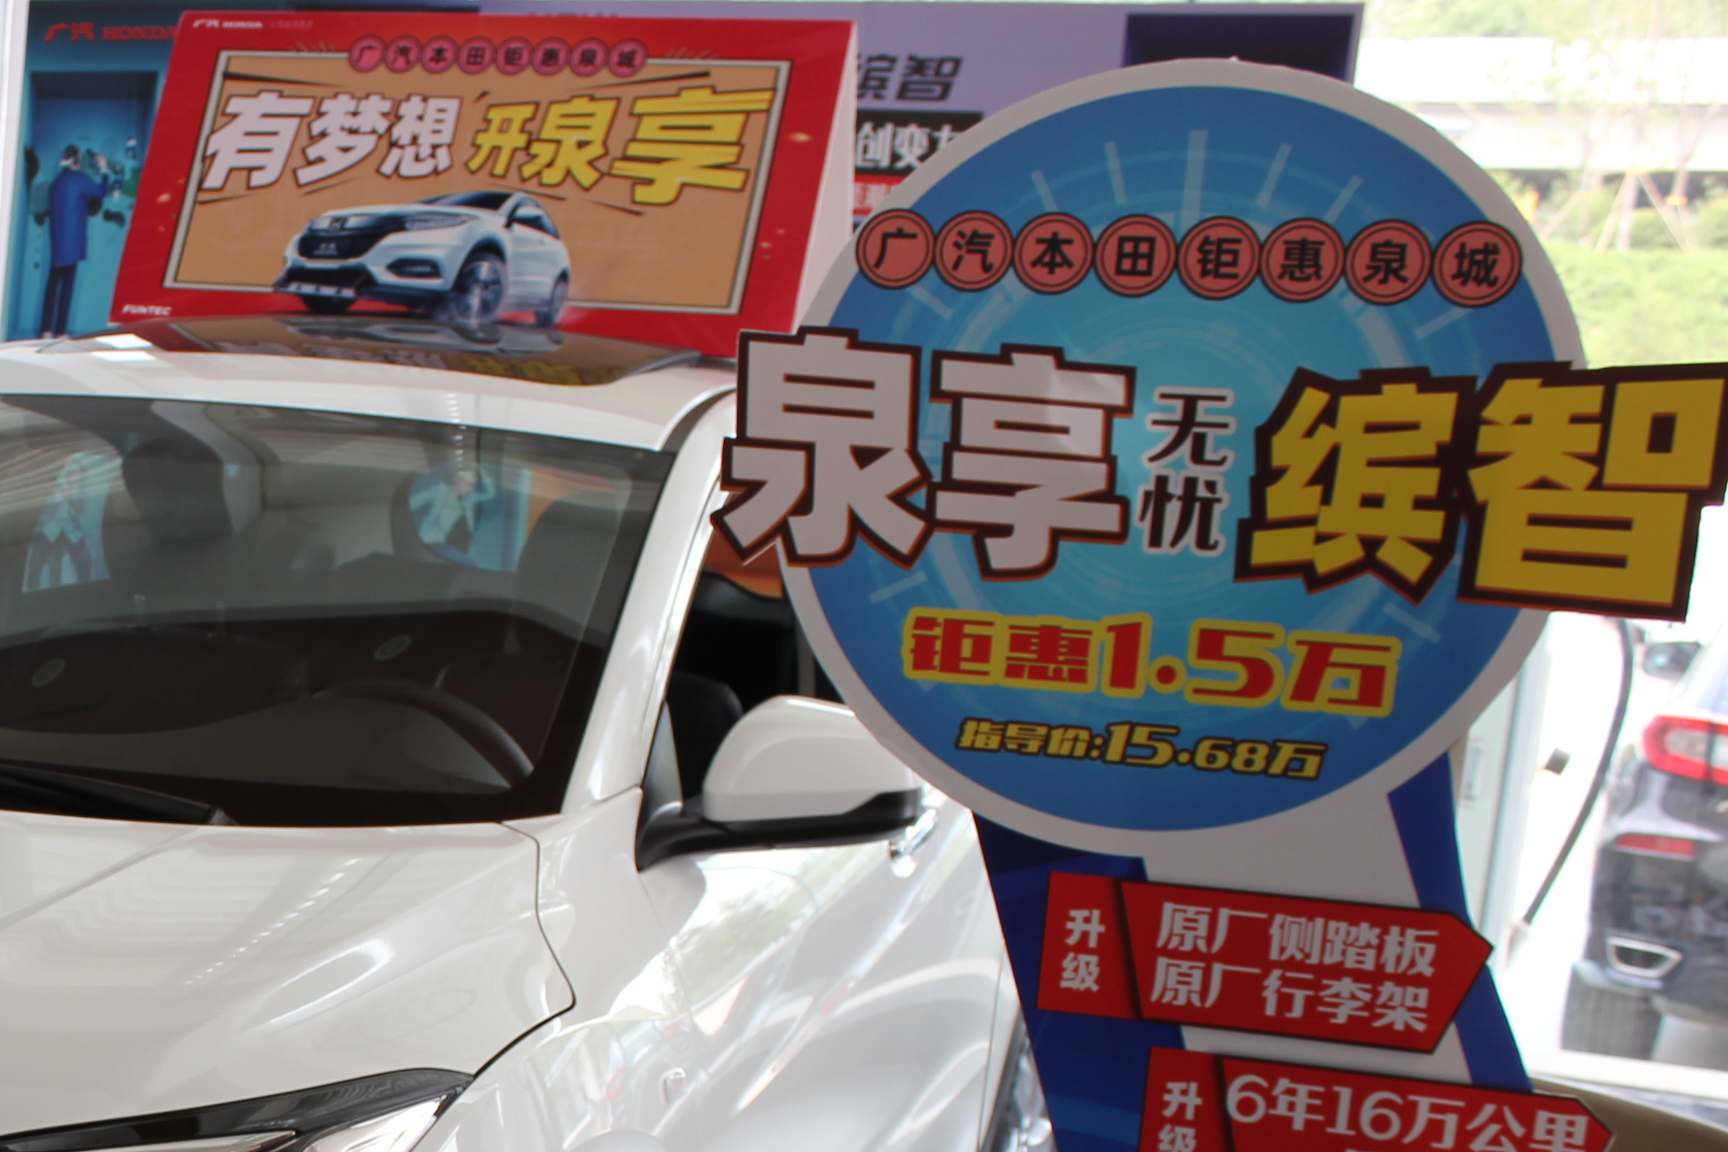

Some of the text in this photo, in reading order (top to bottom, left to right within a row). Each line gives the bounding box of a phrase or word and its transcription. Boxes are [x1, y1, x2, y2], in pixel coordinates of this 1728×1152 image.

[222, 20, 263, 29] HONDA
[200, 86, 776, 206] 有梦想 开泉享
[870, 224, 1502, 291] 广汽本田钜惠泉城
[122, 304, 172, 316] FUNTEC
[718, 332, 1728, 620] 泉享 无忧 缤智
[906, 612, 1398, 714] 钜惠1.5万
[957, 717, 1327, 780] 指导价:15.68万
[1059, 908, 1106, 994] 升级
[1156, 901, 1440, 979] 原厂侧踏板
[1150, 956, 1430, 1035] 原厂行李架
